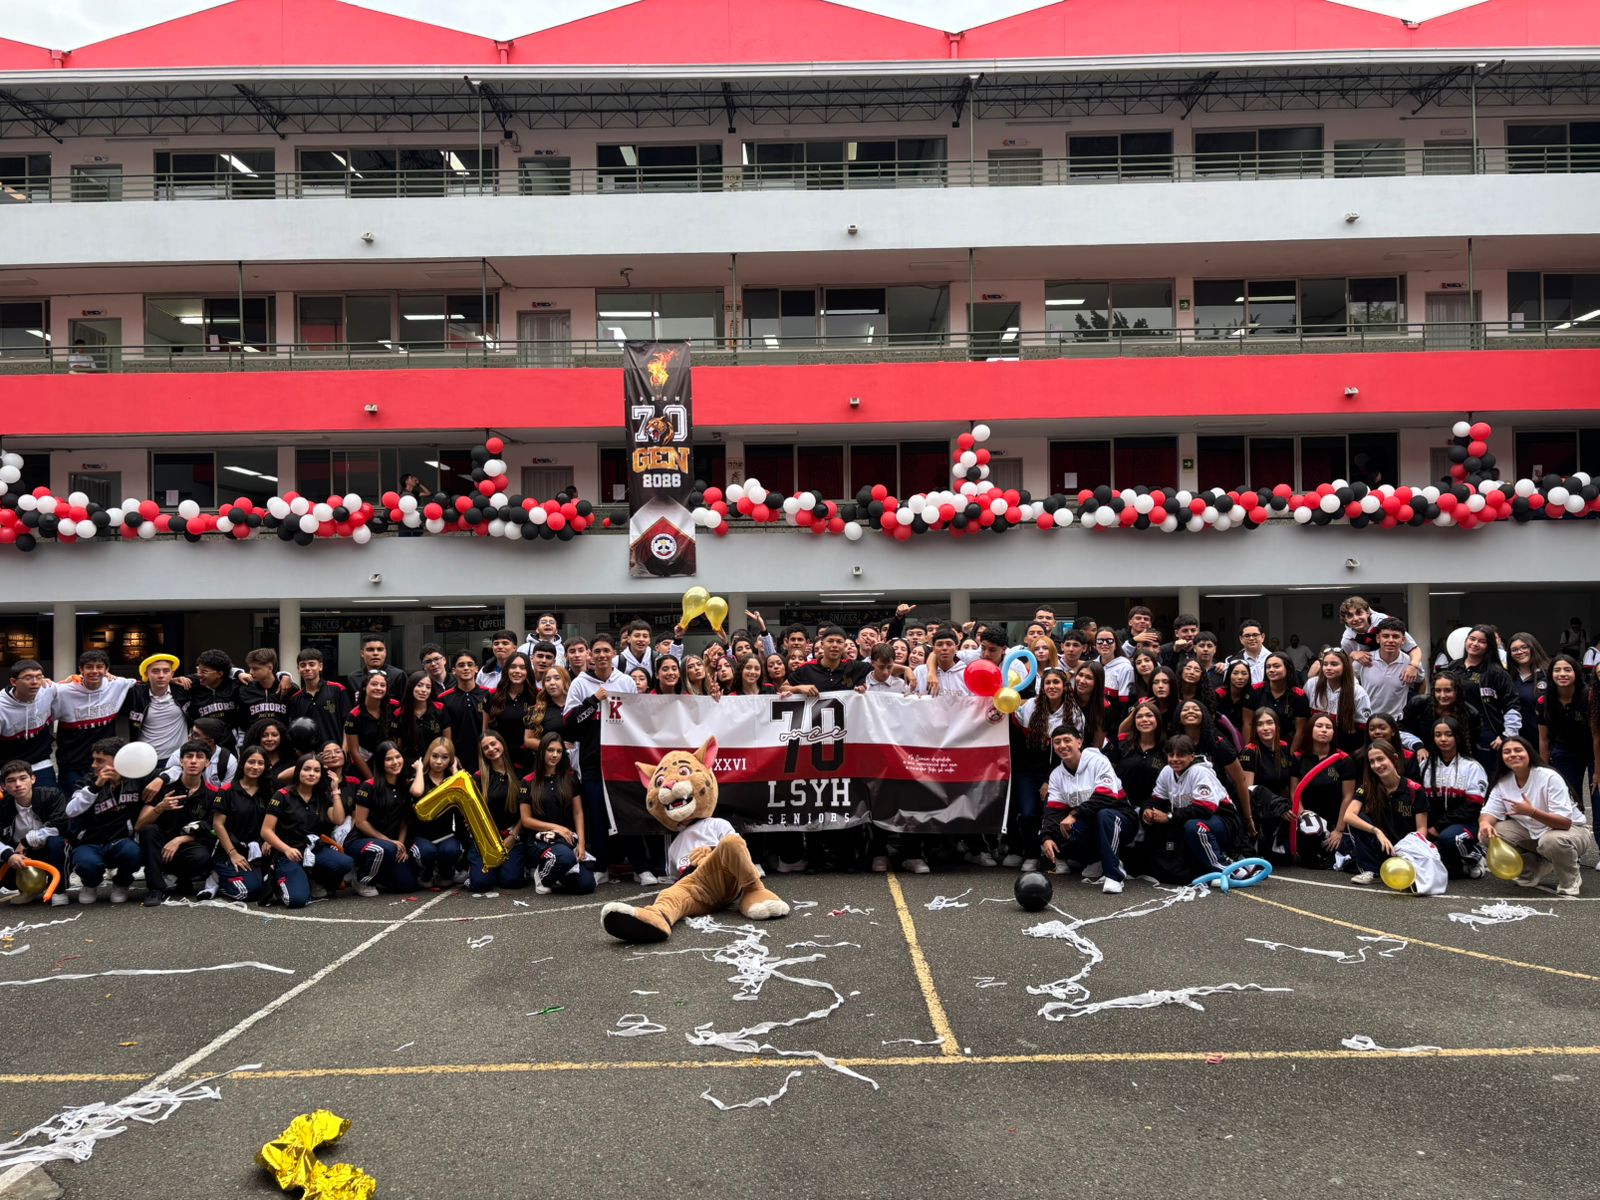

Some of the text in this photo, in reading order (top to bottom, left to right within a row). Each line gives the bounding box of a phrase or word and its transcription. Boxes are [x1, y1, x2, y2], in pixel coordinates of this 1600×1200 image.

[632, 404, 688, 443] 70
[632, 446, 690, 474] GEN
[198, 701, 236, 717] SENIORS
[249, 702, 288, 716] SENIORS
[770, 697, 847, 774] 70
[767, 778, 851, 807] LSYH
[767, 812, 851, 825] SENIORS
